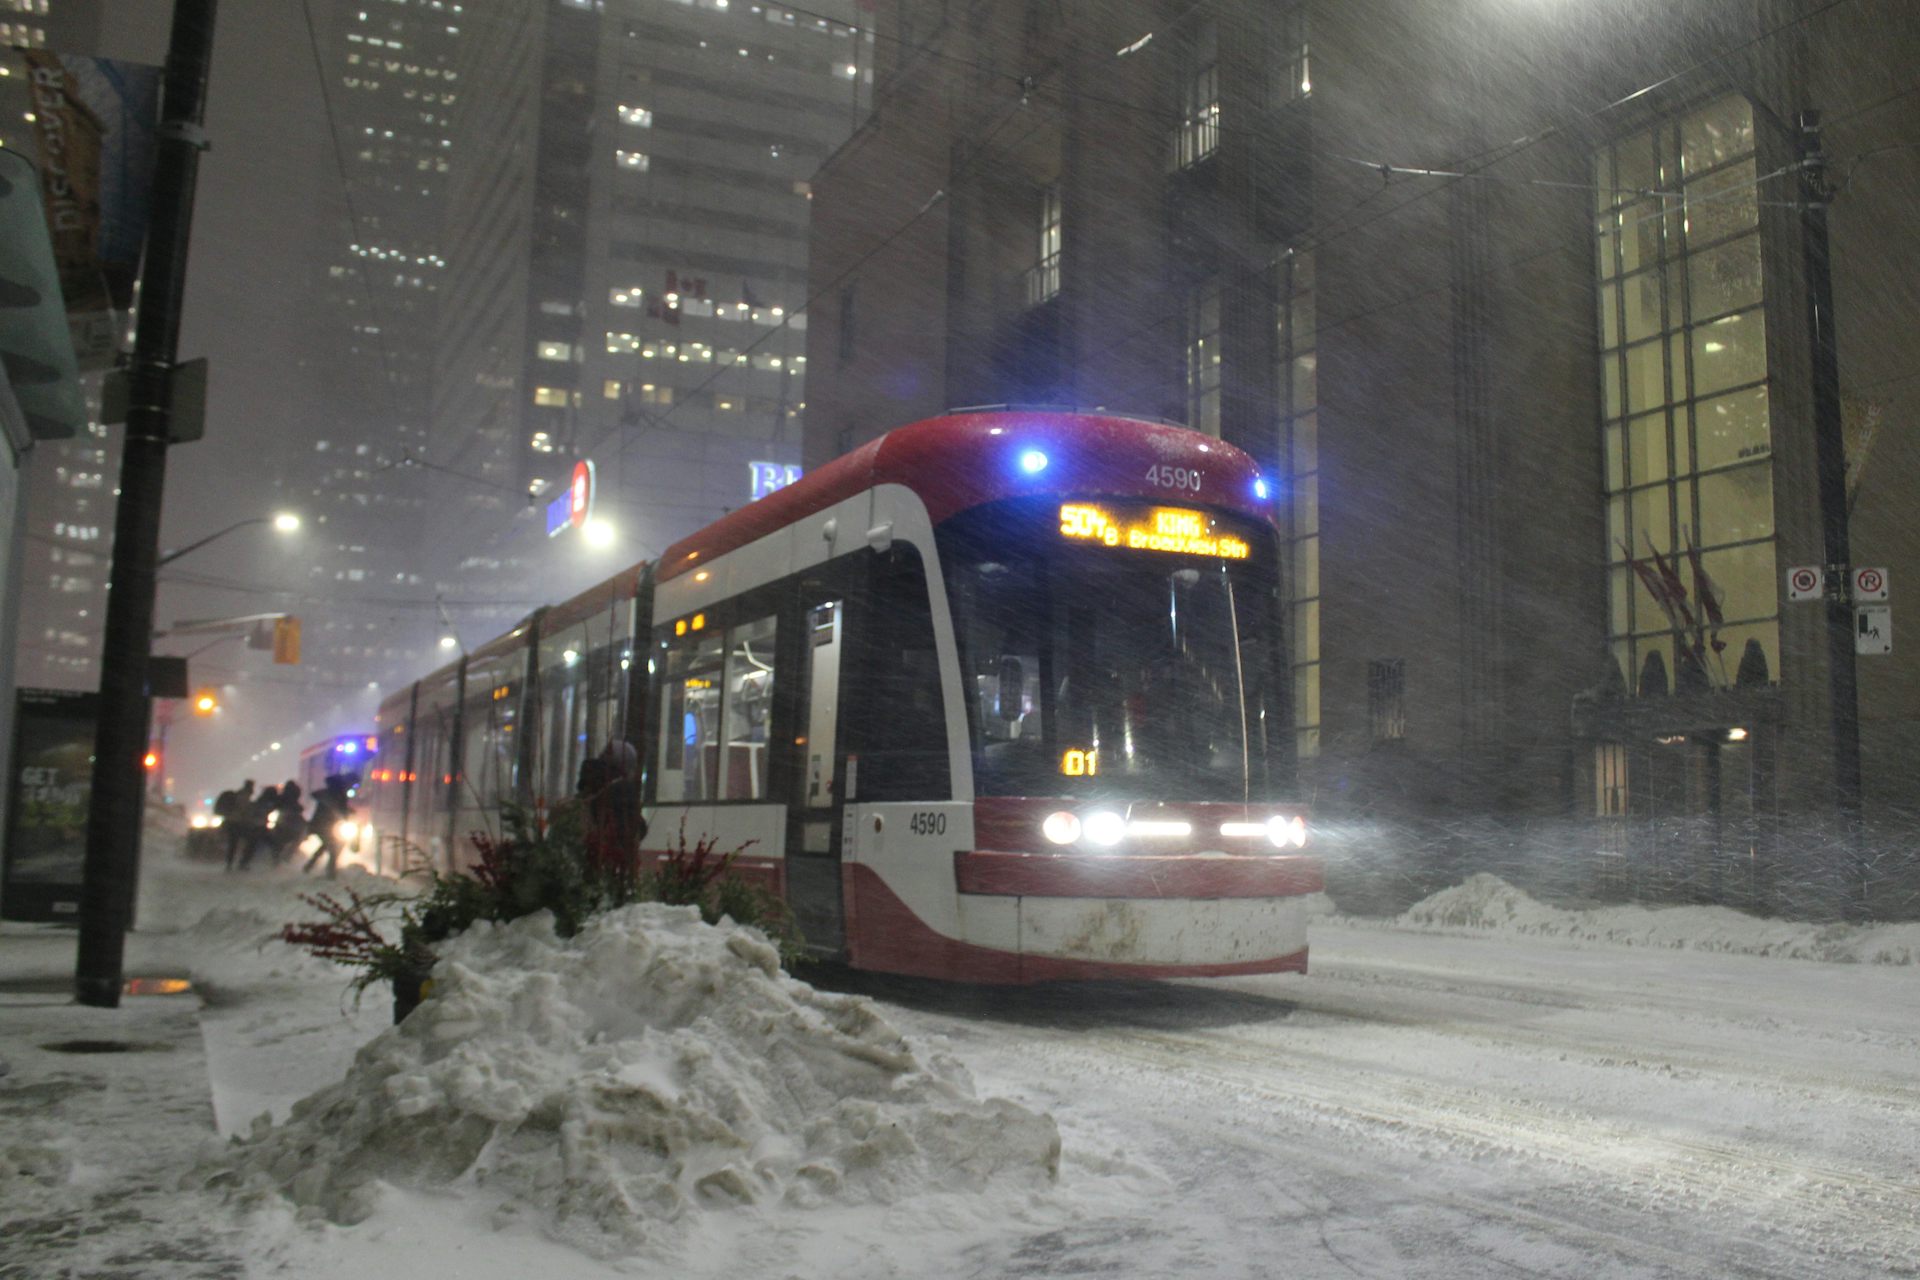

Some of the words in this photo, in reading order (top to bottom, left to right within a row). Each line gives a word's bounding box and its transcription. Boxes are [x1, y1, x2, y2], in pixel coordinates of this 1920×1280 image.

[31, 66, 81, 232] DISCOVER
[1145, 464, 1202, 492] 4590
[1155, 510, 1202, 538] KING
[1218, 538, 1249, 559] Stn
[1063, 750, 1097, 776] 01
[910, 812, 946, 836] 4590
